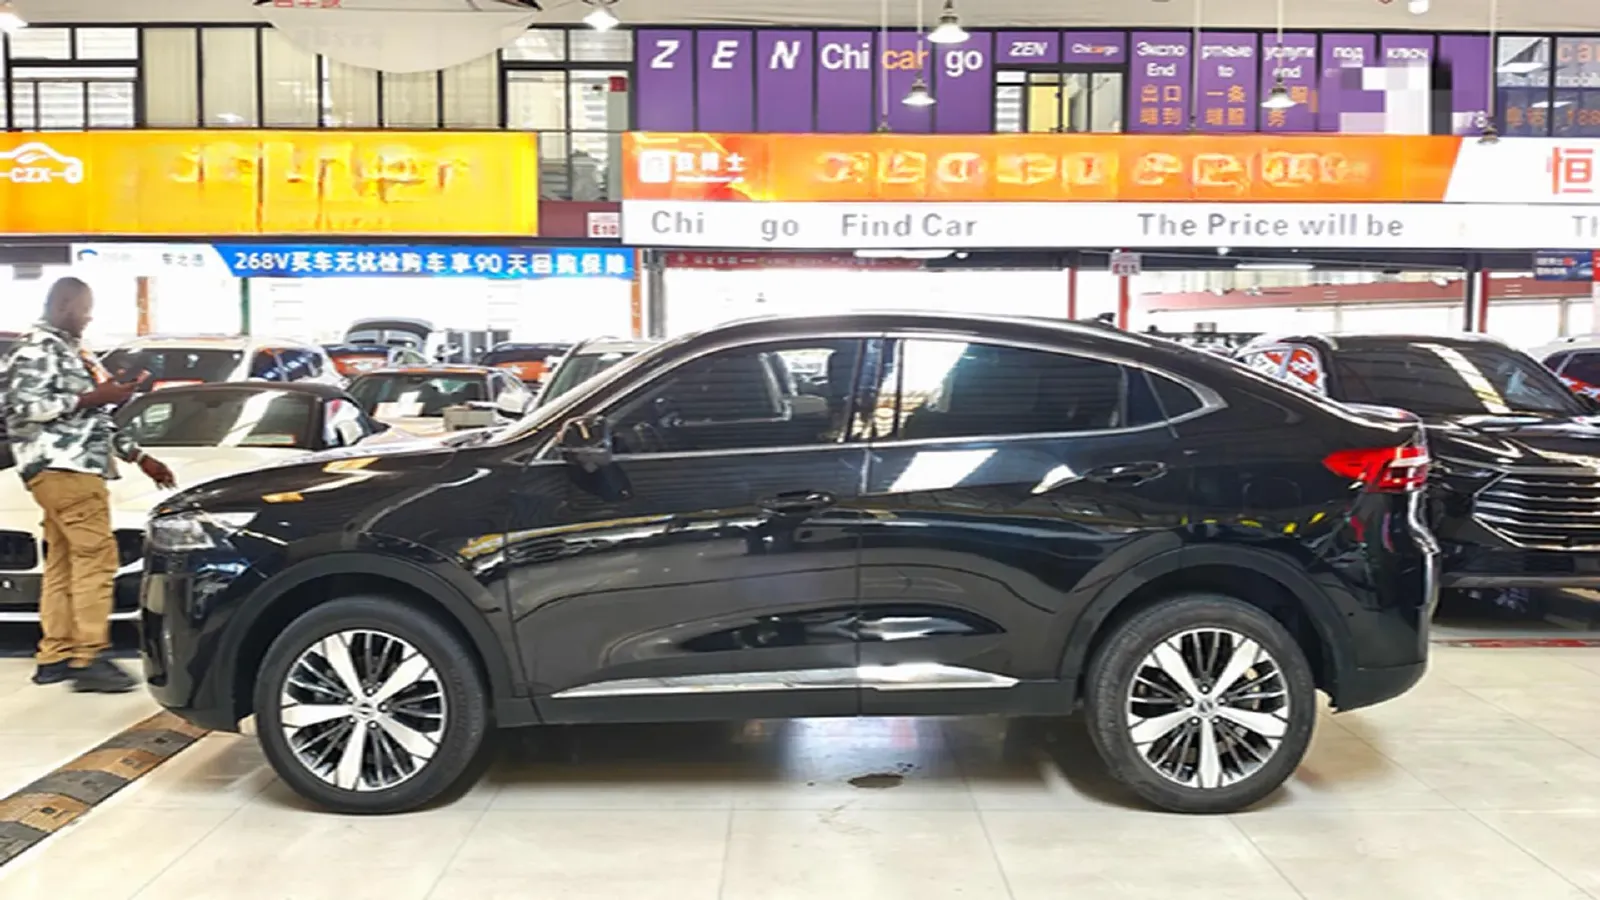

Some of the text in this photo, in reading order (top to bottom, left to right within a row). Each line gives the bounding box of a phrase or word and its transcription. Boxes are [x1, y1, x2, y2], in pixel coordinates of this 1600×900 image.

[650, 40, 801, 71] Z E N
[820, 42, 983, 76] Chi car go
[1009, 41, 1048, 56] ZEN
[1557, 44, 1600, 63] ca
[1146, 62, 1177, 77] End
[1217, 64, 1236, 78] to
[11, 167, 53, 183] CZX
[651, 210, 979, 241] Chi go Find Car
[1137, 211, 1404, 238] The Price will be
